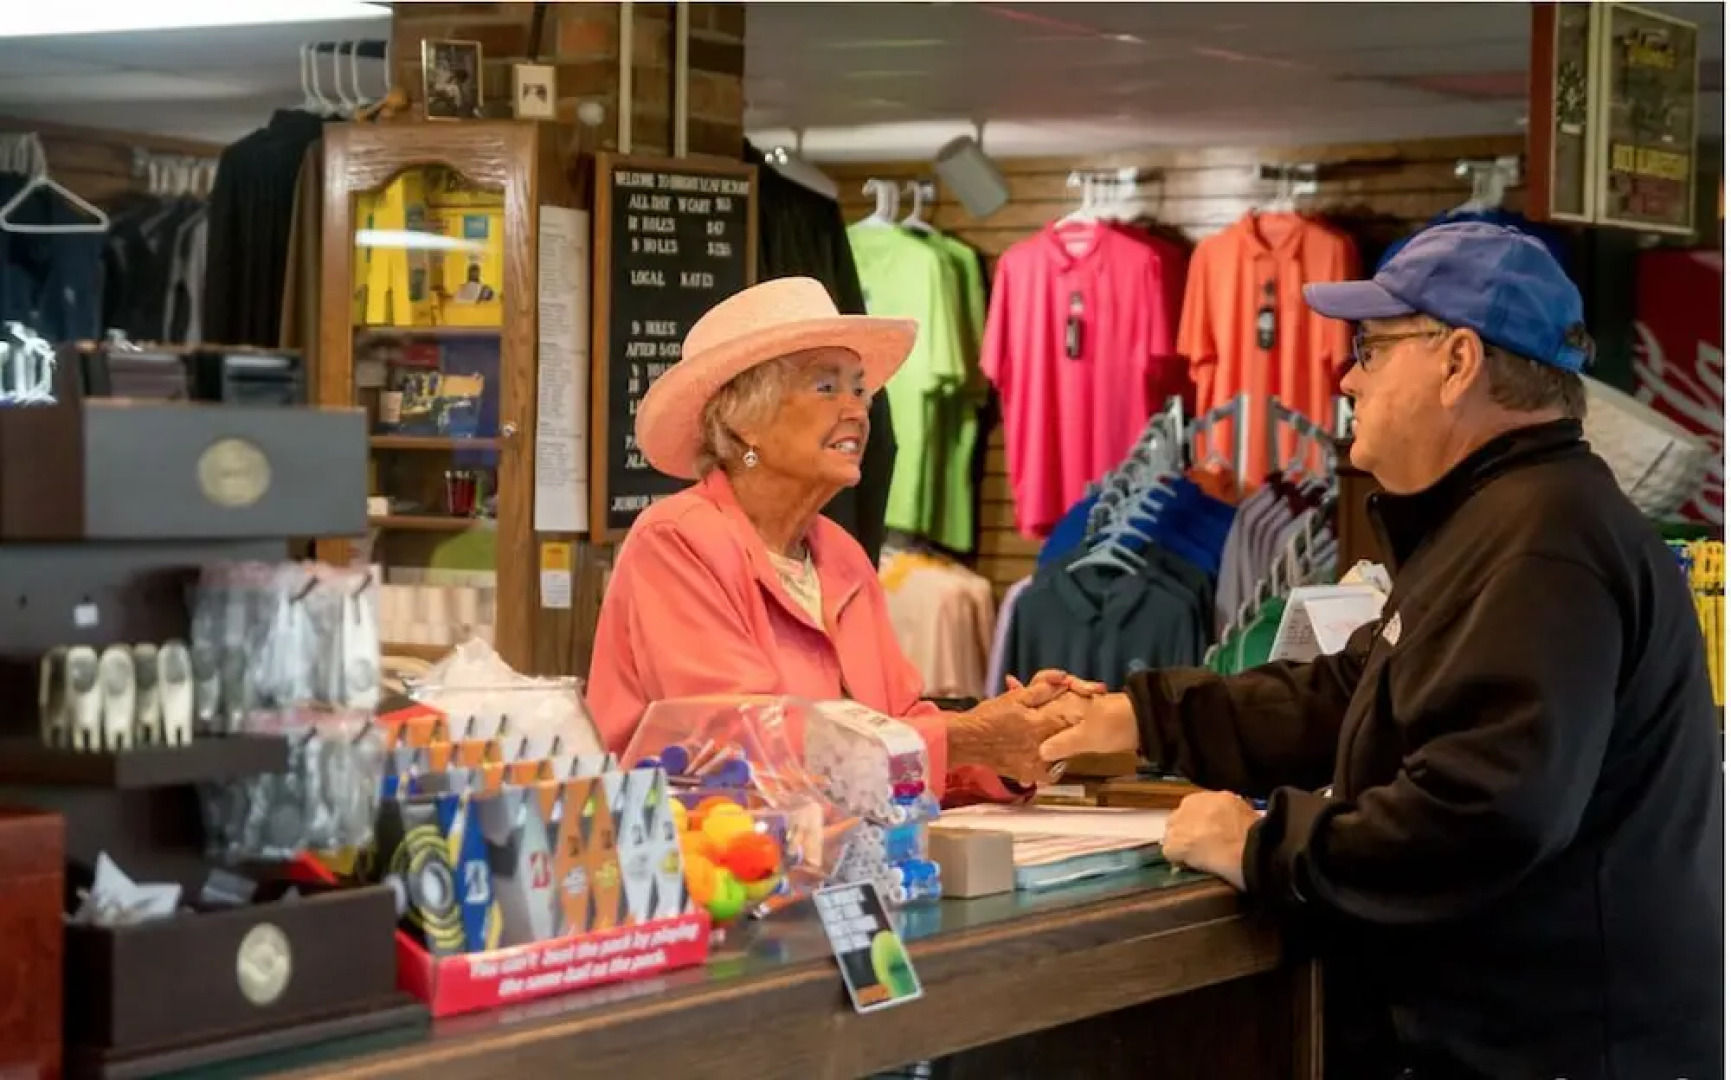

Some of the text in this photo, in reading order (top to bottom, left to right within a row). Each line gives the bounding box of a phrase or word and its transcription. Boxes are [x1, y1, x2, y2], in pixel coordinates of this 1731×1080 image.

[628, 194, 649, 209] ALL
[642, 217, 676, 232] HOLES
[643, 238, 678, 254] HOLES
[630, 270, 666, 287] LOCAL
[645, 320, 678, 335] HOLES
[625, 342, 657, 357] AFTER
